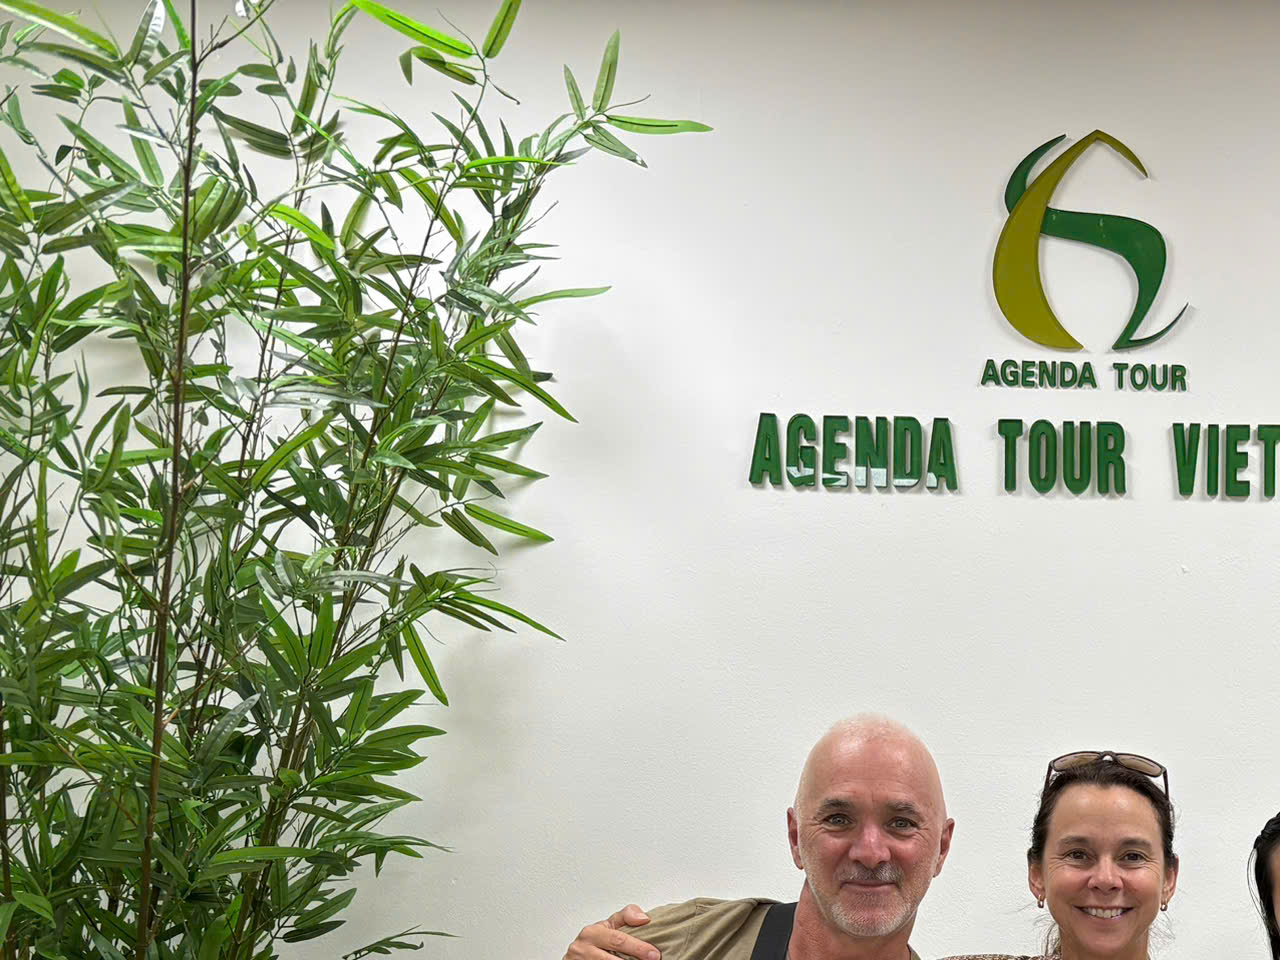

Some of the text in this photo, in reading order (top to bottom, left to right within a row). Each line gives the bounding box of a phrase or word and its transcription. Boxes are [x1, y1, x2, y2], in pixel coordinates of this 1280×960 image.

[980, 359, 1187, 391] AGENDA TOUR
[748, 412, 959, 493] AGENDA
[998, 418, 1128, 496] TOUR
